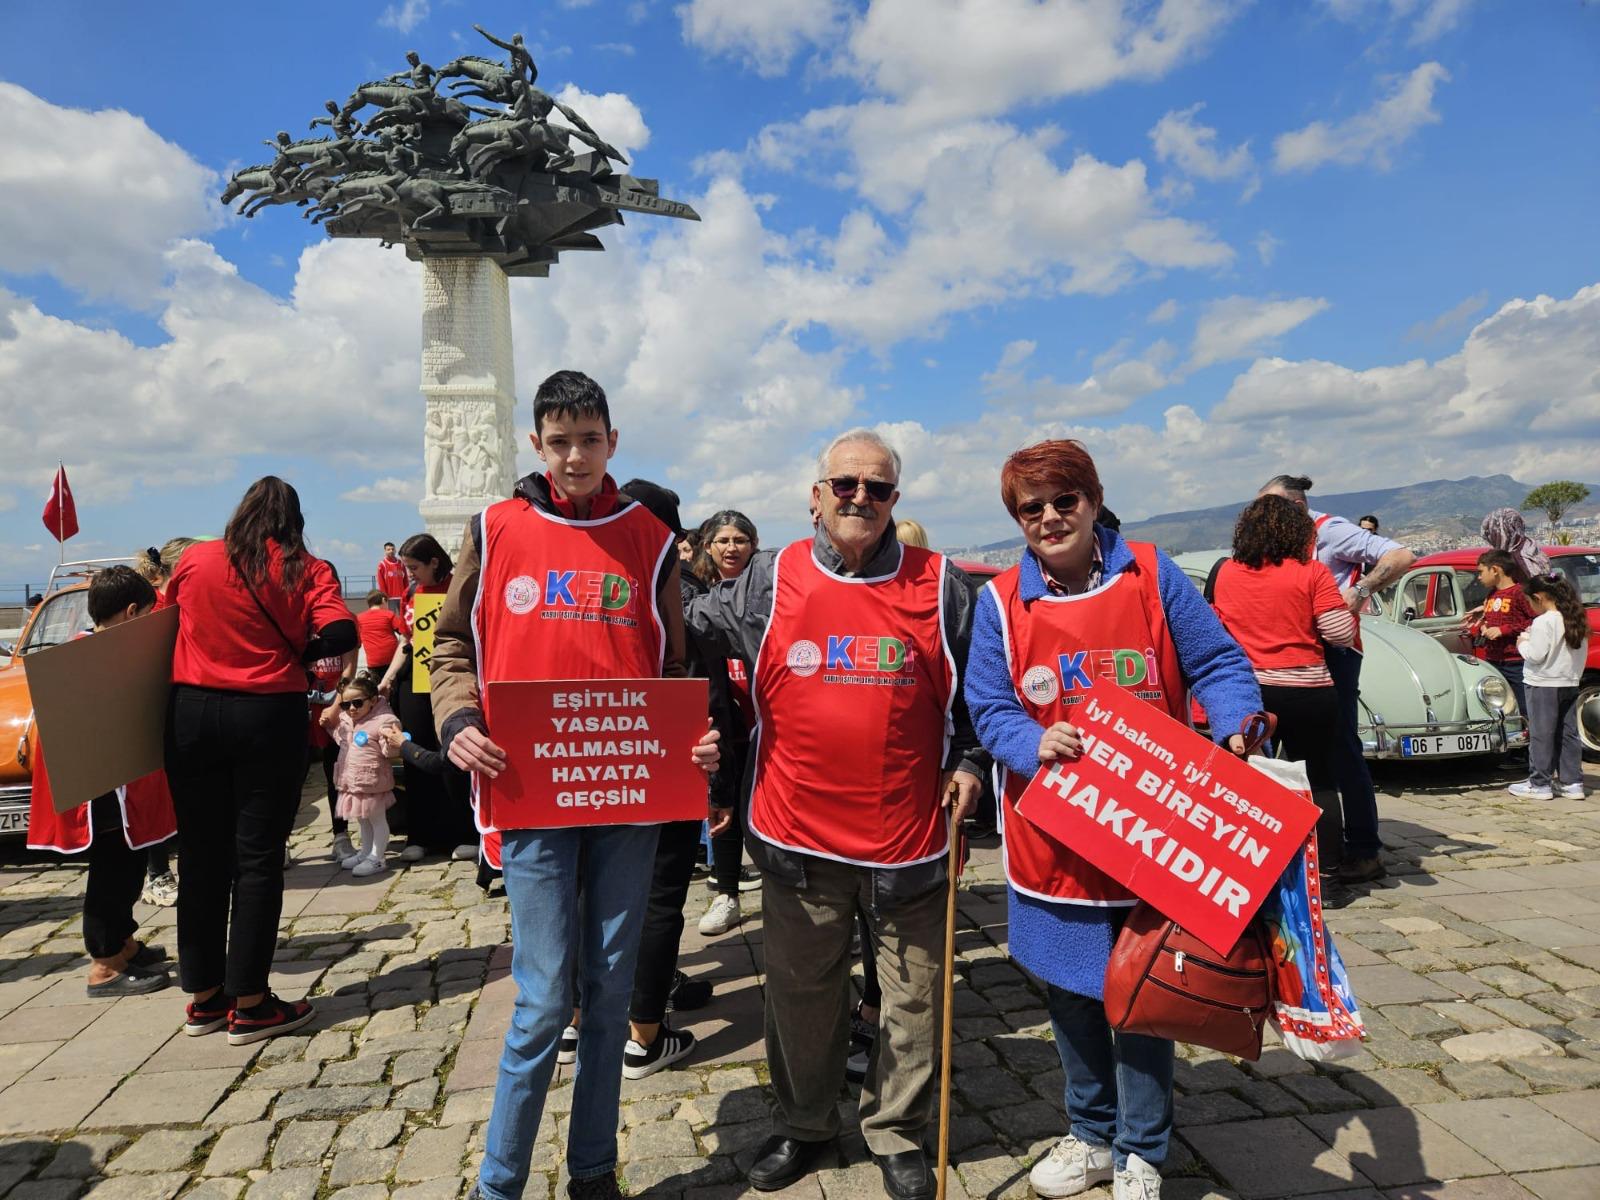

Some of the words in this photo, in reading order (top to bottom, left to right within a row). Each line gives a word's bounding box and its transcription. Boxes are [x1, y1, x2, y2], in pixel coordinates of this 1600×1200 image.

[553, 688, 647, 711] EŞİTLİK
[551, 716, 649, 733] YASADA
[534, 739, 667, 759] KALMASIN,
[1412, 738, 1428, 754] 06
[1436, 737, 1443, 753] F
[1458, 734, 1488, 751] 0871
[552, 764, 650, 783] HAYATA
[1112, 716, 1178, 770] bakım,
[1183, 760, 1211, 786] iyi
[1212, 778, 1284, 835] yaşam
[556, 788, 646, 810] GEÇSİN
[1077, 727, 1133, 780] HER
[1135, 769, 1271, 868] BİREYİN
[1041, 762, 1252, 919] HAKKIDIR
